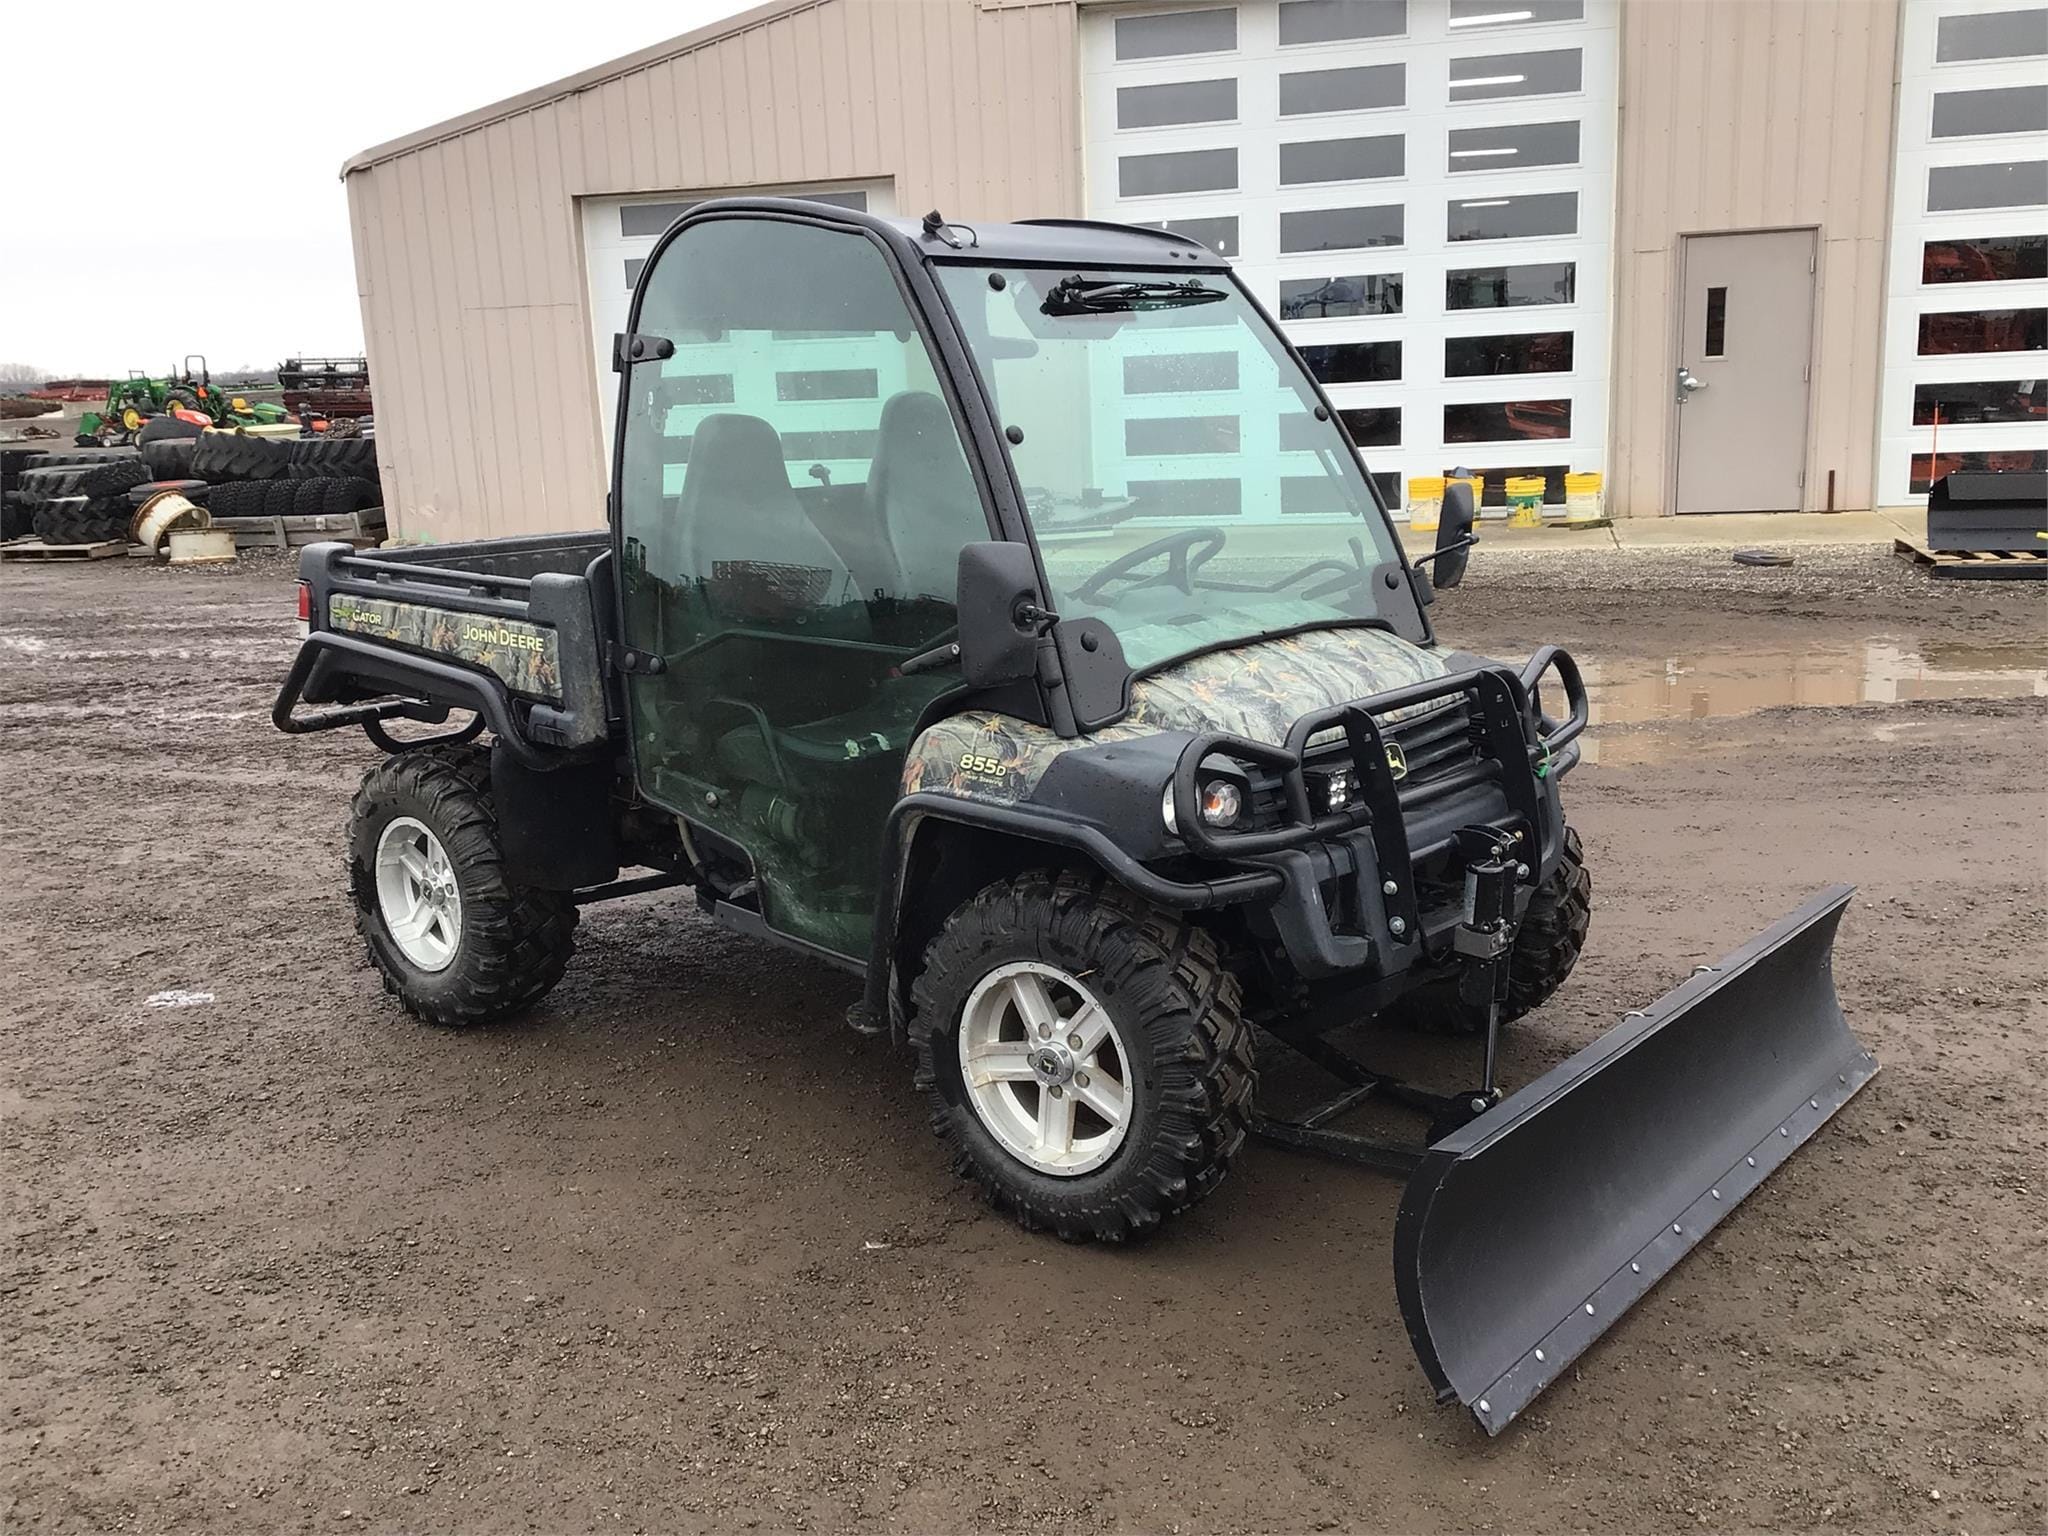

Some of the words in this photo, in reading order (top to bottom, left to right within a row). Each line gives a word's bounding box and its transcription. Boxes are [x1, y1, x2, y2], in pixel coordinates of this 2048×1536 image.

[352, 609, 381, 624] GATOR
[462, 623, 497, 644] JOHN
[500, 629, 544, 652] DEERE
[960, 753, 1006, 776] 855D
